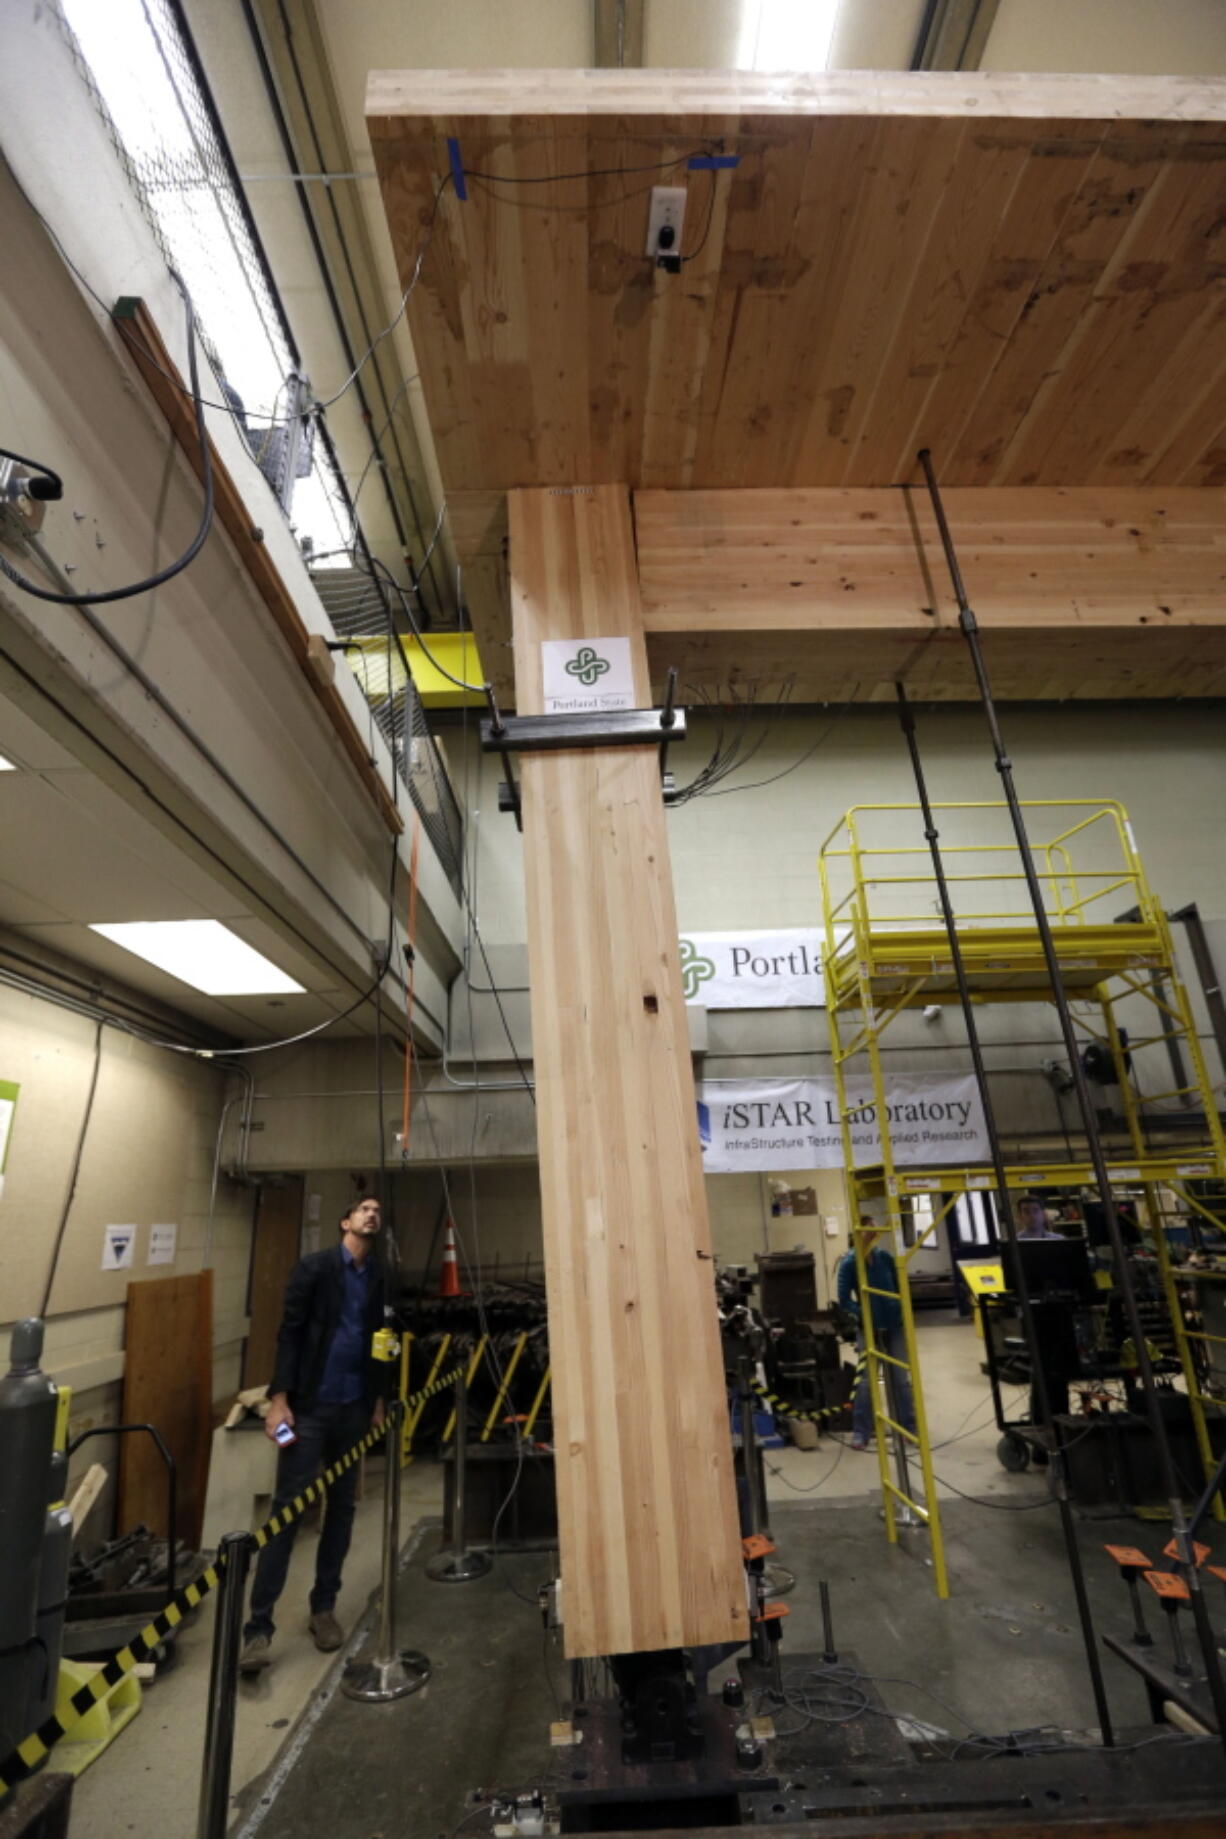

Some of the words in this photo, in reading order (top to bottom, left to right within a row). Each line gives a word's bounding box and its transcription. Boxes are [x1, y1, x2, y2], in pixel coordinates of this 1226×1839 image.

[552, 698, 598, 709] Portland
[722, 1101, 816, 1129] iSTAR
[806, 1134, 845, 1147] Testin
